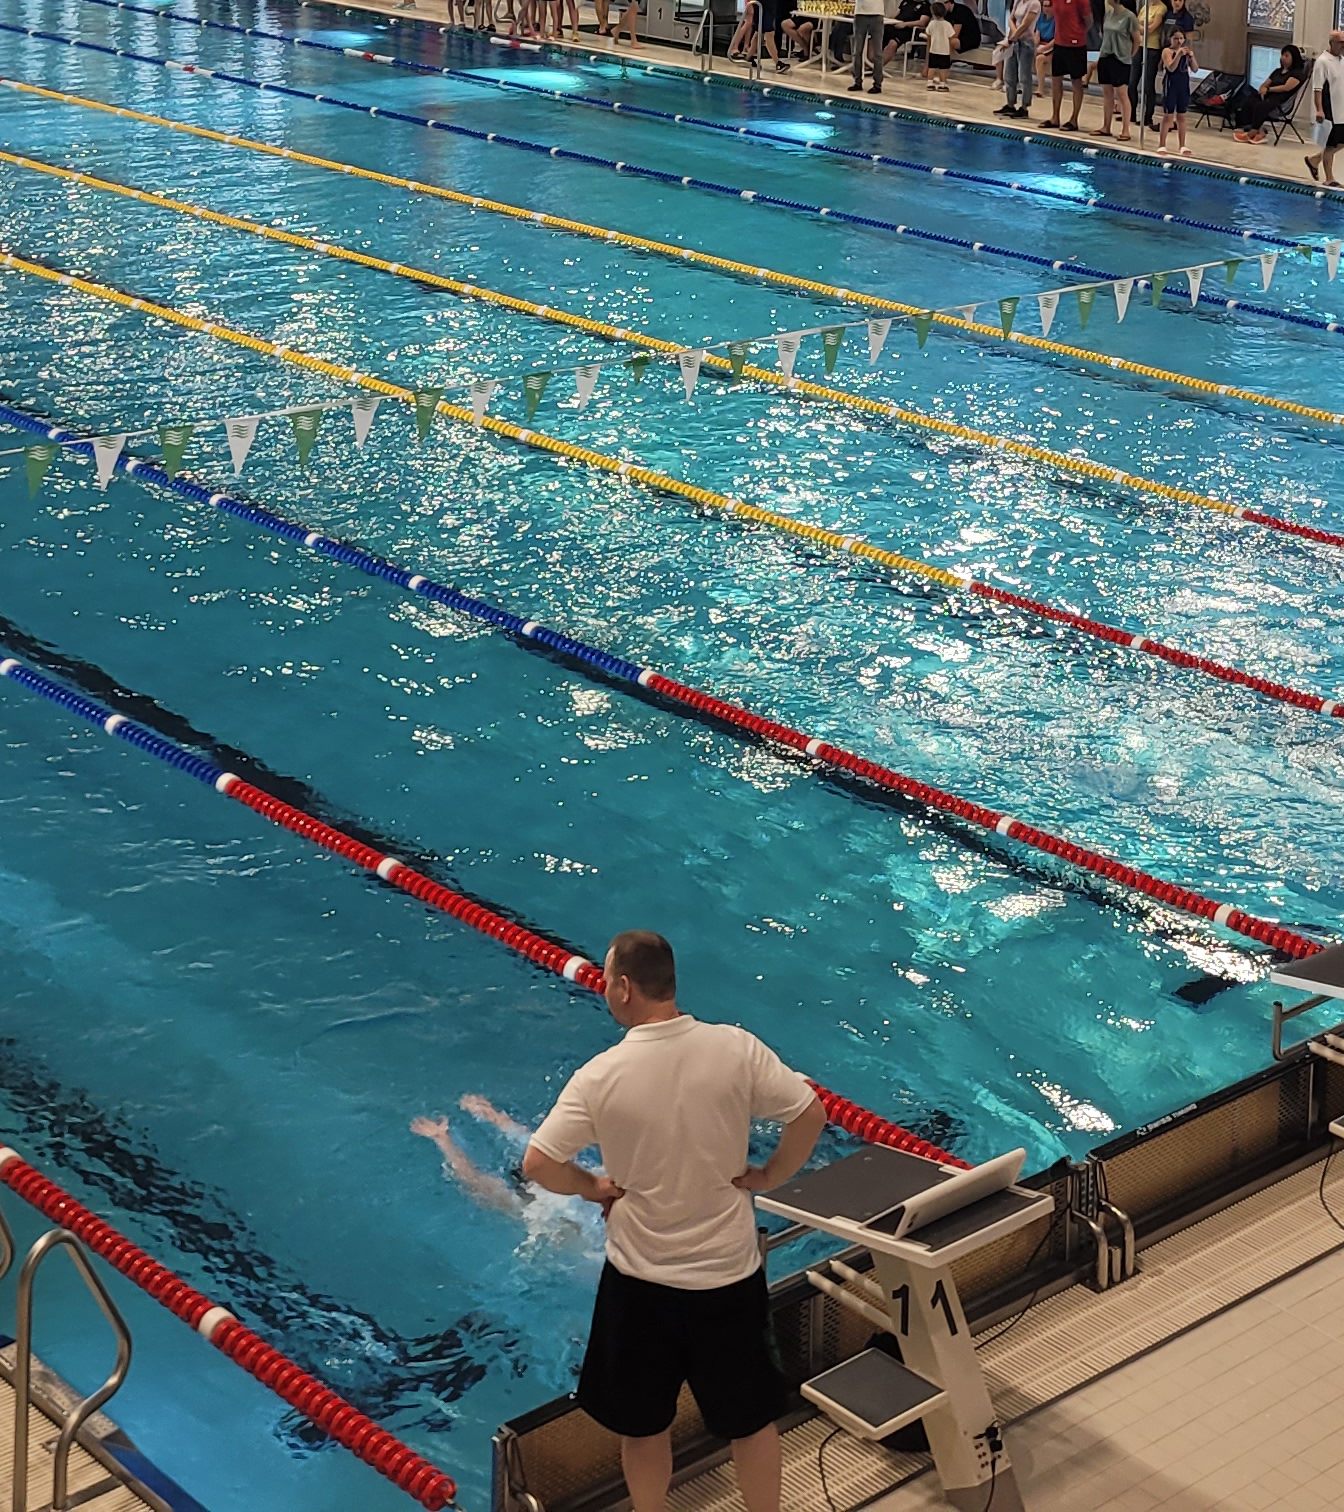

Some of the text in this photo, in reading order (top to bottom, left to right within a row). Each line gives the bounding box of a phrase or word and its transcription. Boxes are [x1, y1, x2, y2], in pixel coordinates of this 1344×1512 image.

[658, 8, 662, 20] 1
[684, 27, 690, 39] 3
[892, 1283, 909, 1337] 1
[930, 1279, 958, 1336] 1
